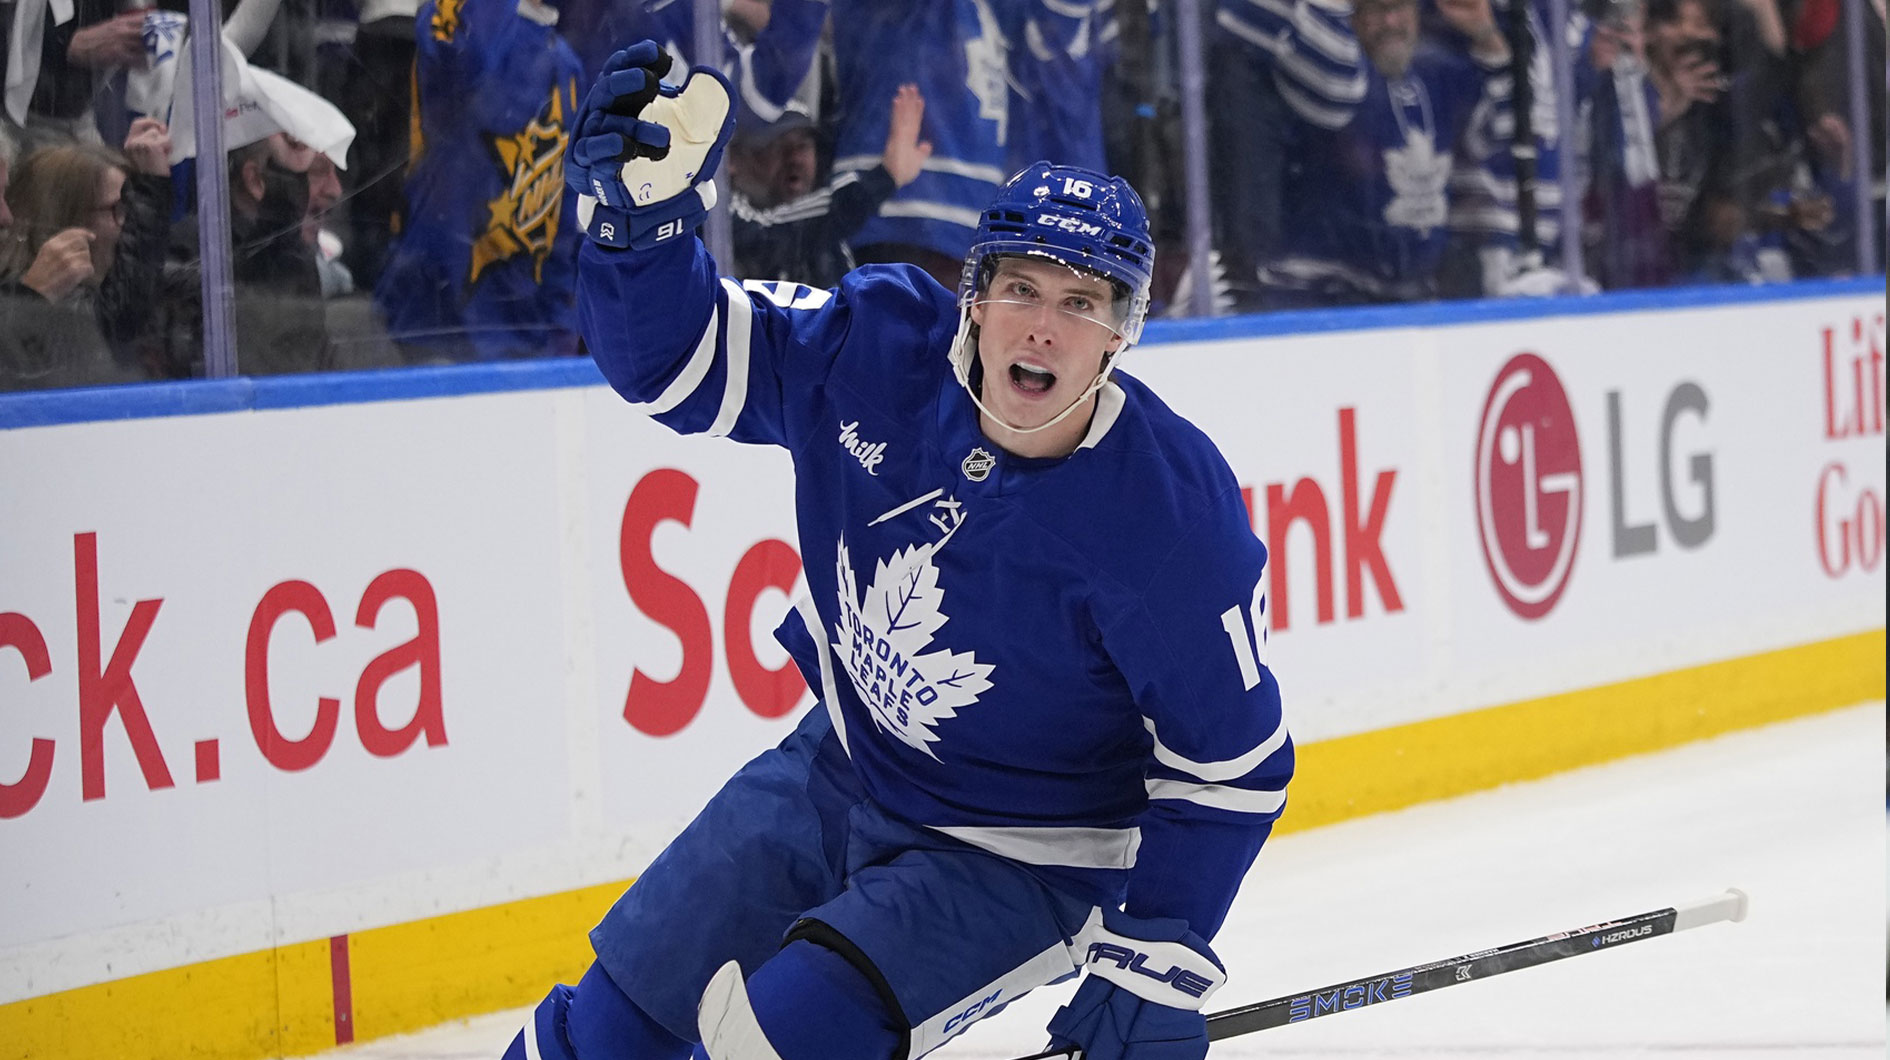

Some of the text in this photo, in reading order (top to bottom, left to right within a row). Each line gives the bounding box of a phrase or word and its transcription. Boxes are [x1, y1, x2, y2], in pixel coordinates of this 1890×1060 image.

[1063, 177, 1093, 198] 16
[655, 218, 684, 241] 16
[1037, 213, 1103, 236] CCM
[1606, 380, 1717, 560] LG
[1241, 407, 1404, 632] nk
[1815, 460, 1886, 579] Go
[844, 601, 938, 707] TORONTO
[852, 633, 914, 711] MAPLE
[850, 650, 910, 727] LEAFS
[1602, 925, 1653, 945] HZRDUS
[1085, 942, 1214, 998] RUE
[1289, 973, 1415, 1023] SMOKE
[943, 988, 1003, 1033] CCM
